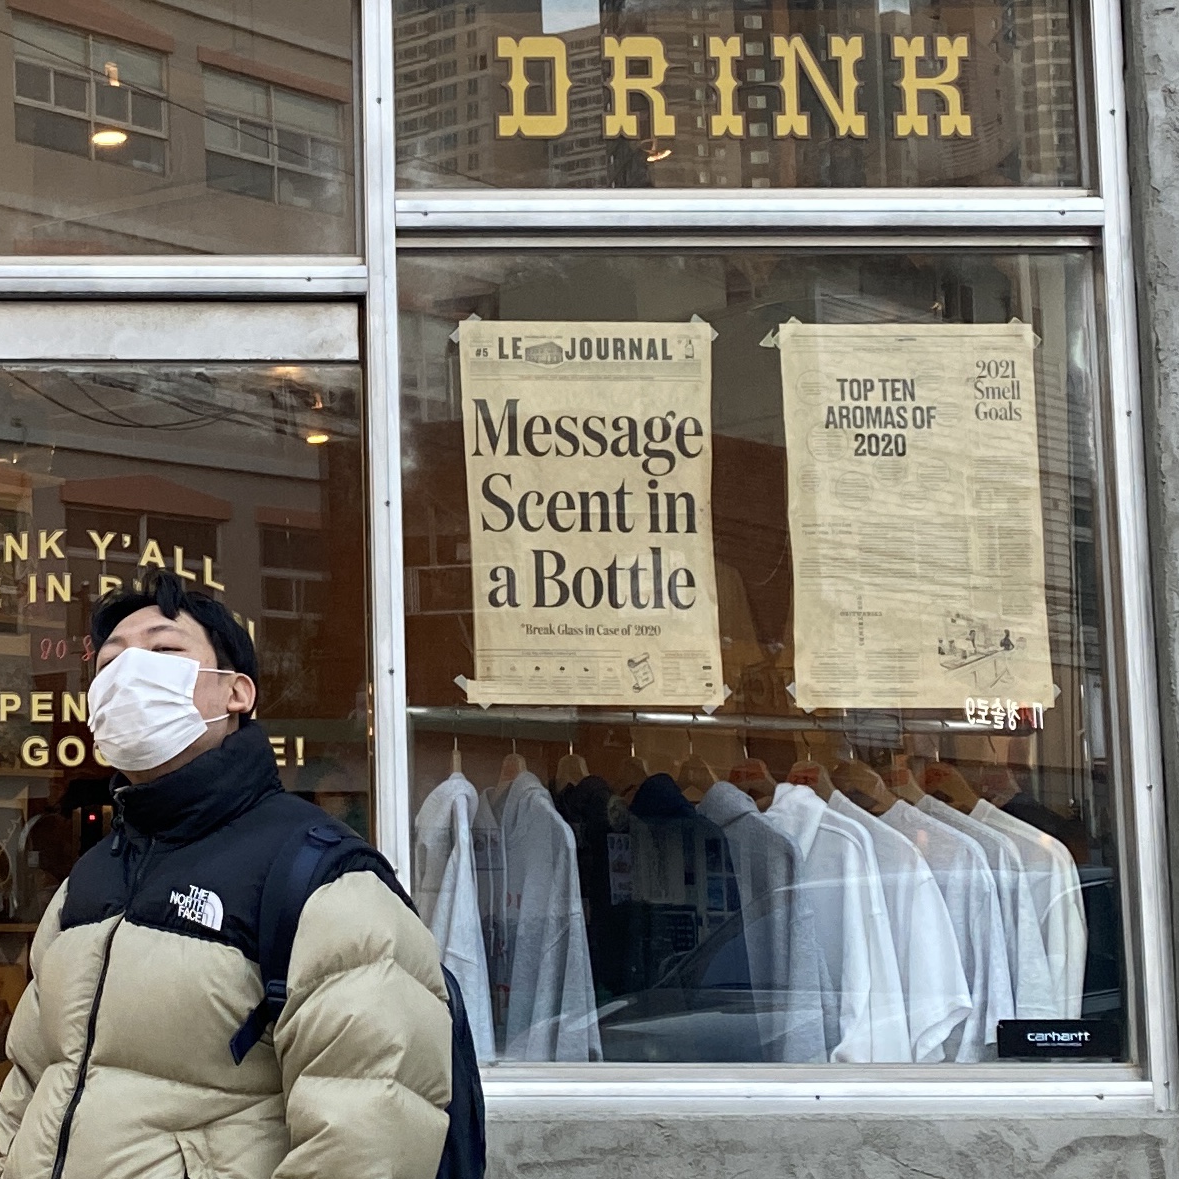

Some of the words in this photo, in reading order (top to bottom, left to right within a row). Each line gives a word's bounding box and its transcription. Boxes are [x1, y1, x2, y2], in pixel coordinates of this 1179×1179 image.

[495, 34, 973, 139] DRINK
[475, 347, 489, 358] #5
[498, 337, 522, 360] LE
[564, 337, 673, 361] JOURNAL
[975, 359, 1016, 379] 2021
[836, 378, 875, 402] TOP
[881, 378, 916, 402] TEN
[974, 380, 1021, 400] Smell
[825, 406, 908, 429] AROMAS
[913, 406, 937, 429] OF
[975, 402, 1022, 422] Goals
[471, 398, 704, 476] Message
[854, 433, 907, 457] 2020
[481, 473, 636, 533] Scent
[647, 479, 698, 533] in
[87, 530, 225, 592] Y'ALL
[28, 573, 71, 603] IN
[488, 565, 520, 608] a
[532, 546, 696, 610] Bottle
[557, 624, 583, 637] Glass
[584, 624, 595, 637] in
[597, 624, 619, 637] Case
[621, 624, 632, 637] of
[634, 624, 662, 637] 2020
[169, 890, 205, 912] NORTH
[189, 884, 210, 900] THE
[177, 905, 203, 923] FACE
[1027, 1031, 1091, 1042] carhartt
